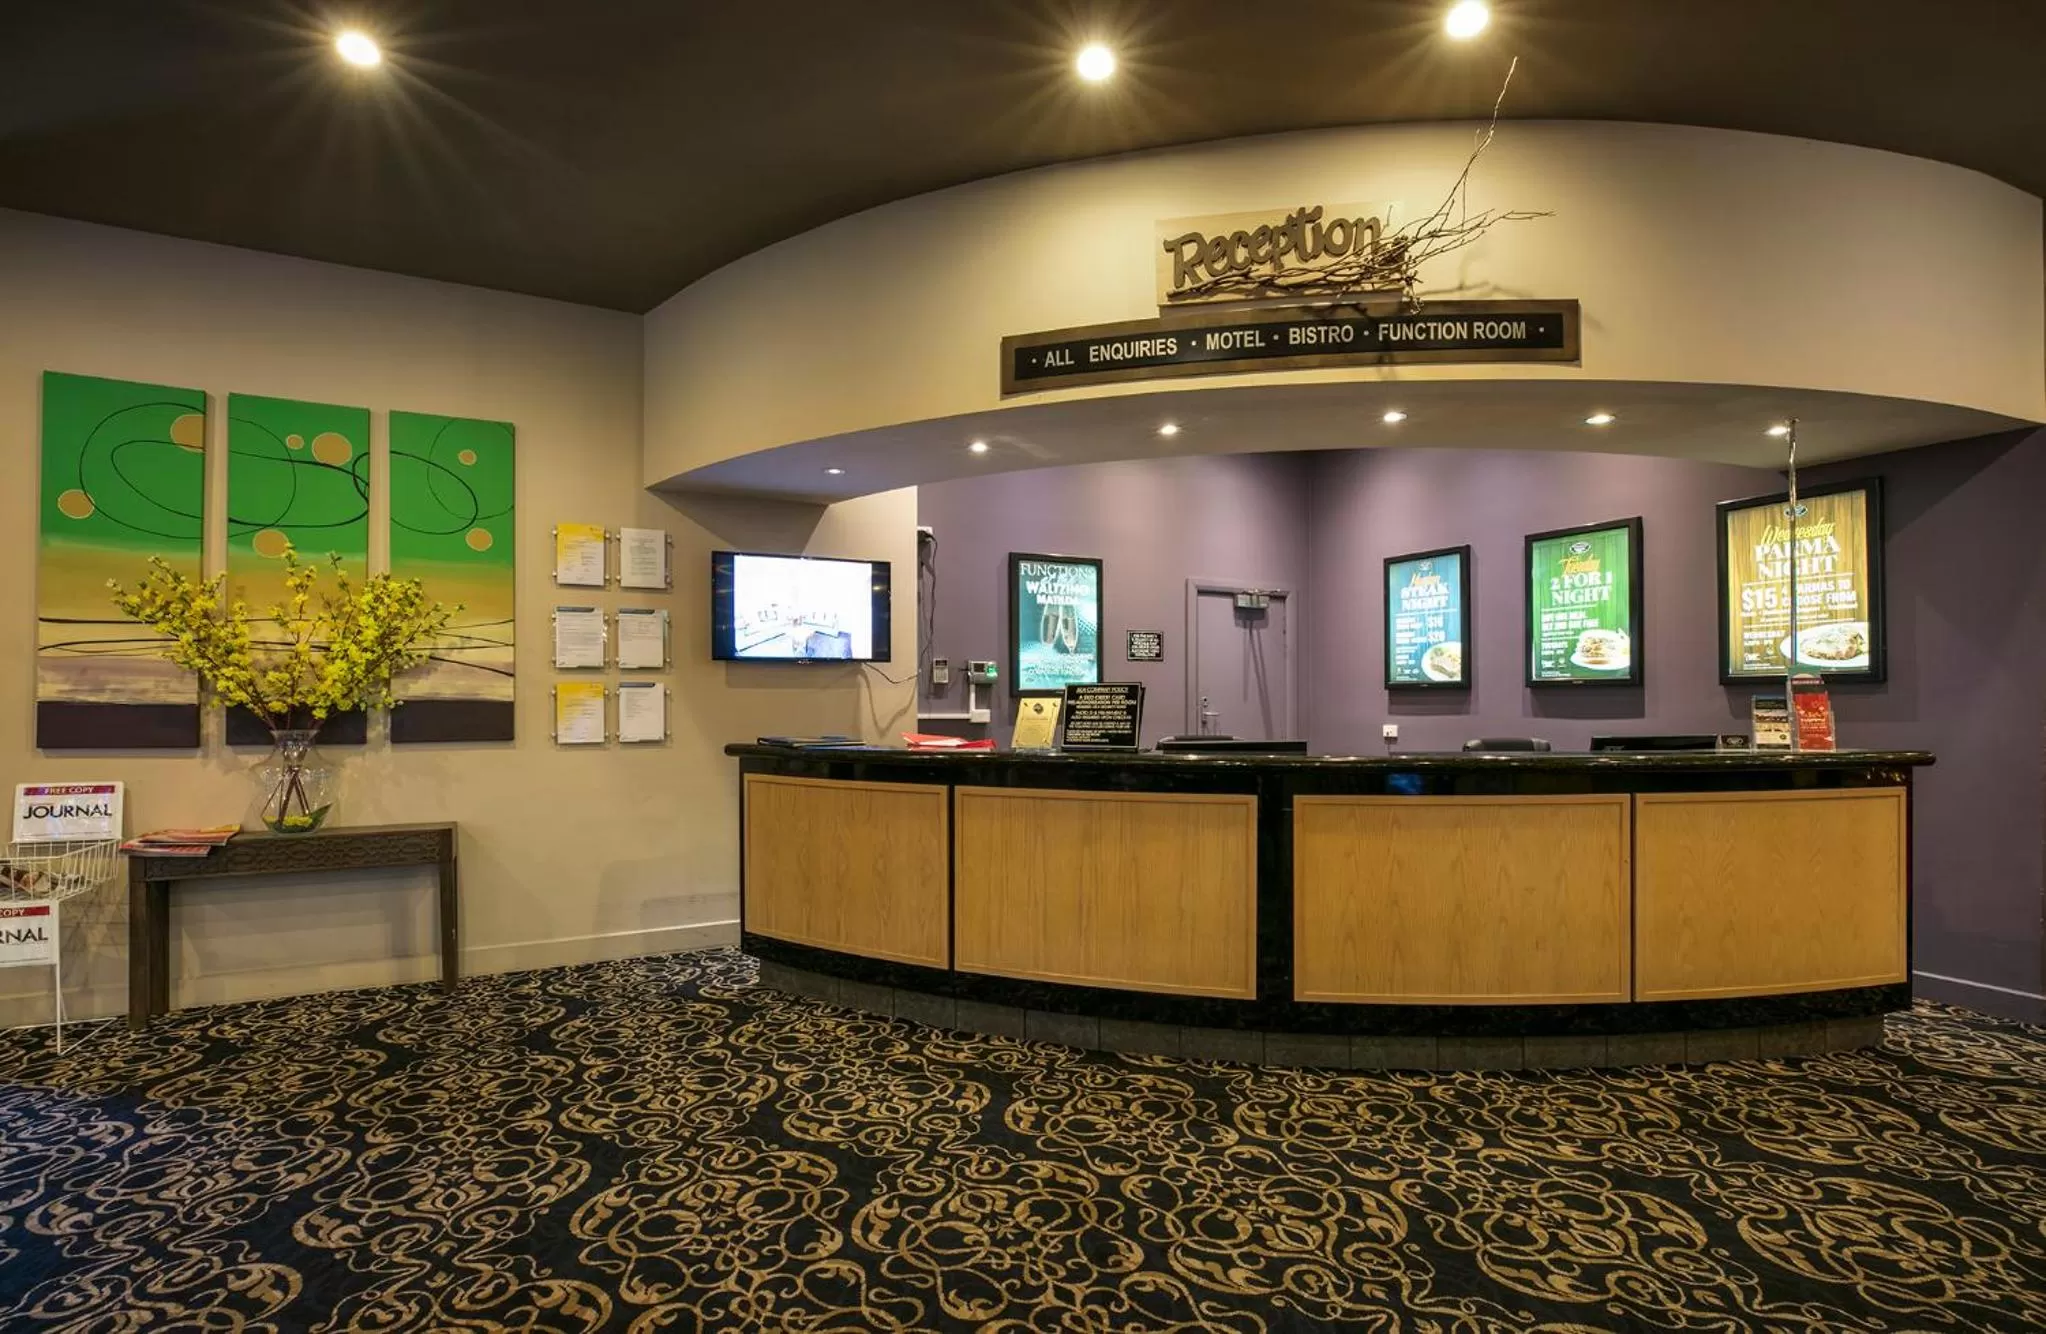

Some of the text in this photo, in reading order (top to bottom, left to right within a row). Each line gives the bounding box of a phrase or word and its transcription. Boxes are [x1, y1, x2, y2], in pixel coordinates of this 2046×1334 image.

[1163, 205, 1382, 289] Reception
[1044, 321, 1526, 368] ALL ENQUIRIES MOTEL BISTRO FUNCTION ROOM
[1552, 586, 1613, 606] NIGHT
[1741, 586, 1777, 614] $15
[69, 786, 94, 794] COPY
[23, 803, 112, 820] JOURNAL
